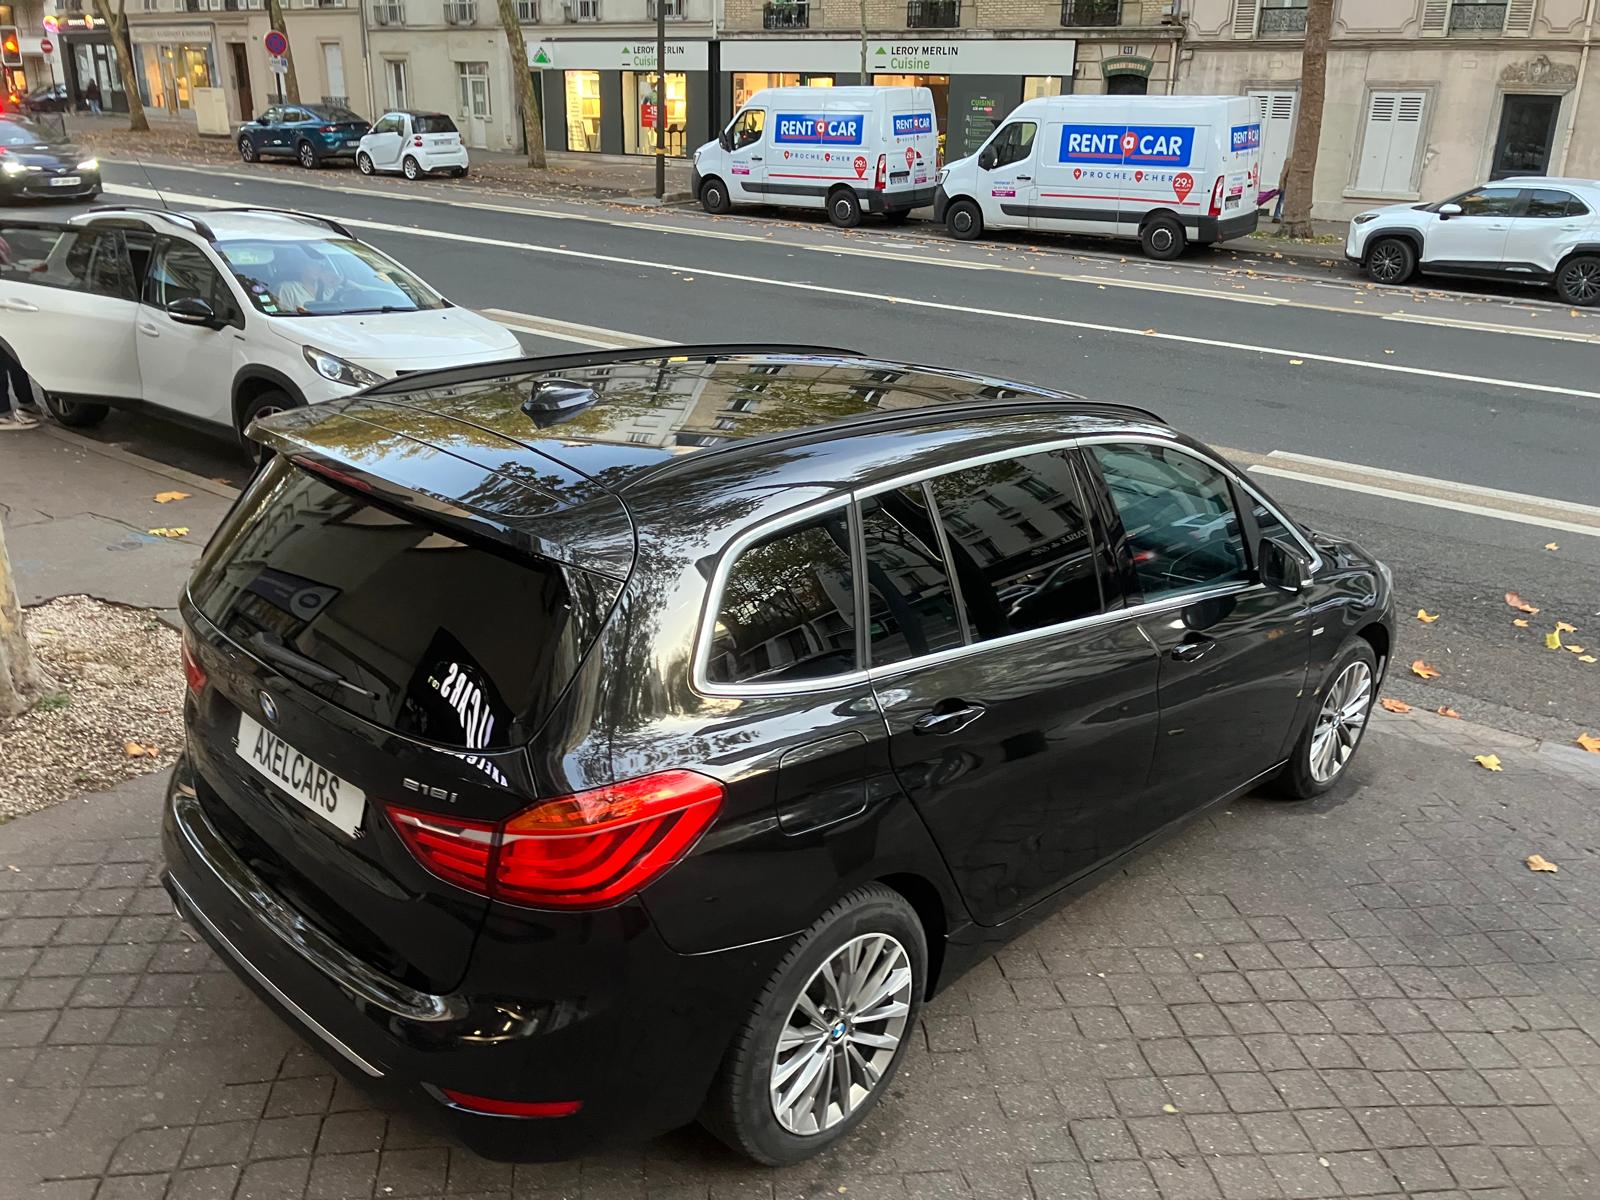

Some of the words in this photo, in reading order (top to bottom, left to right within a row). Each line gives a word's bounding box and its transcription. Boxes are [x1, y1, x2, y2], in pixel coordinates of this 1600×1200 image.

[633, 46, 654, 54] LEROY
[664, 46, 685, 54] ERLIN
[891, 46, 919, 55] LEROY
[922, 46, 959, 56] MERLIN
[890, 57, 930, 70] Cuisine
[781, 120, 814, 136] RENT
[828, 121, 857, 136] CAR
[896, 119, 913, 130] RENT
[919, 117, 931, 128] CAR
[1233, 131, 1247, 144] RENT
[1068, 133, 1118, 154] RENT
[1139, 135, 1183, 156] CAR
[1144, 174, 1173, 182] CHER
[252, 726, 340, 813] AXELCARS
